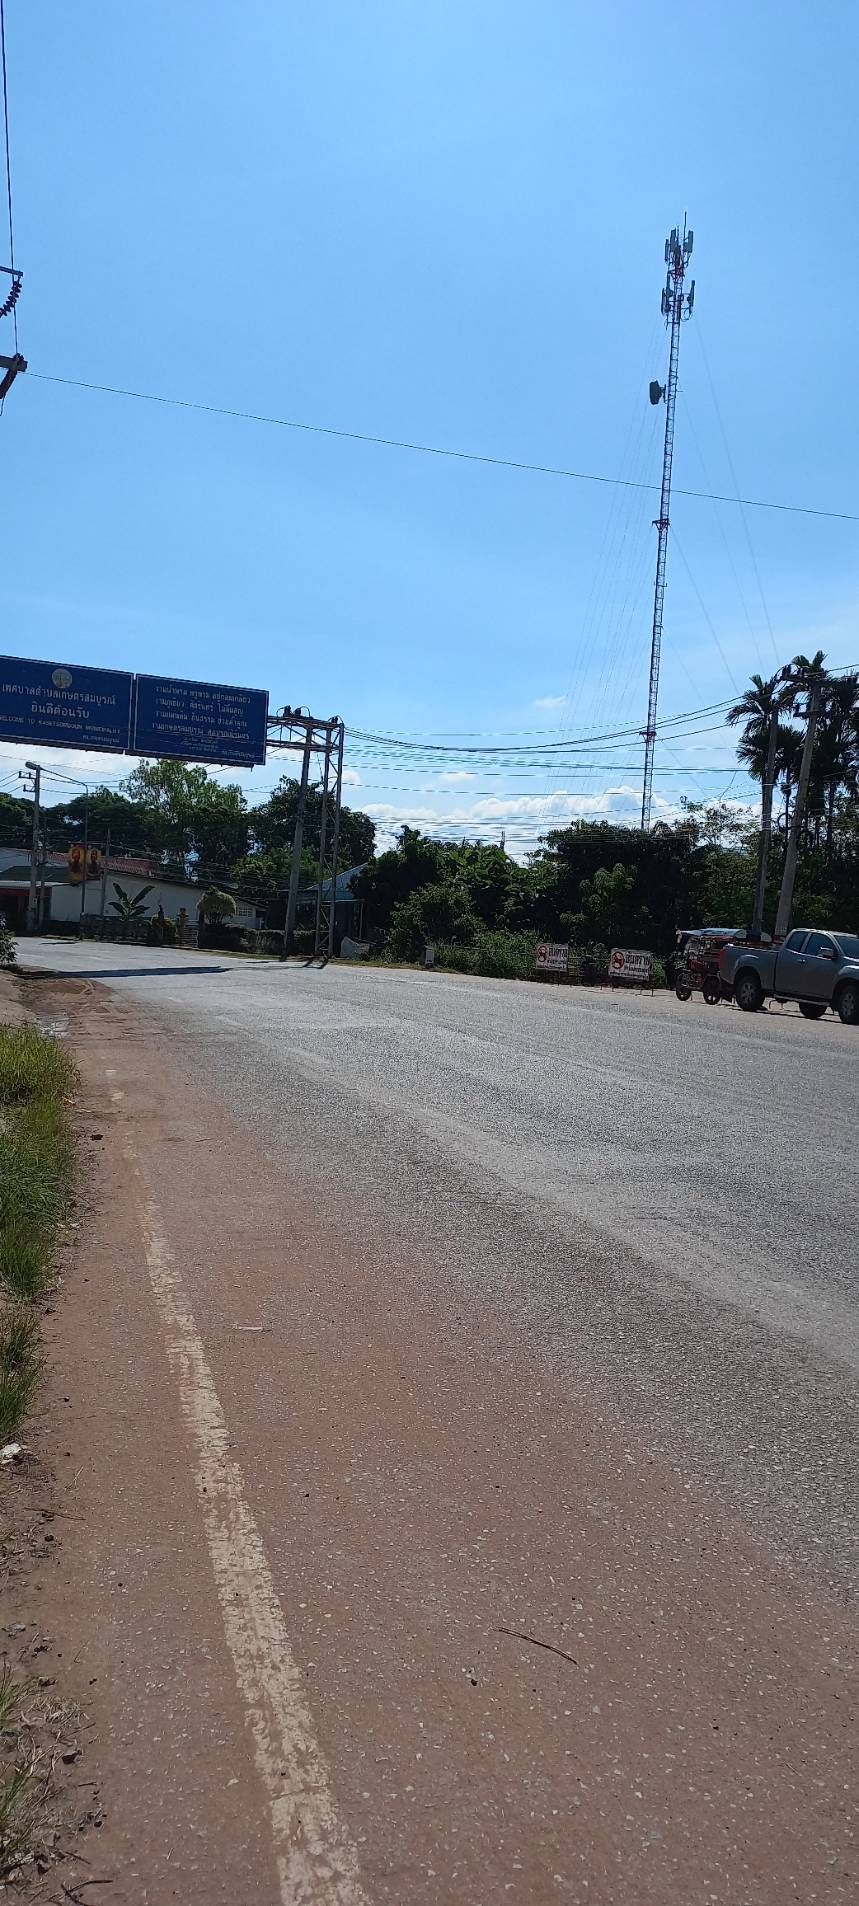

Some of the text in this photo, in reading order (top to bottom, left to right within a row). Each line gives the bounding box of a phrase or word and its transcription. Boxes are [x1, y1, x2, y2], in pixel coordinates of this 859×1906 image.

[31, 701, 90, 719] ยินดีต้อนรับ
[27, 717, 36, 725] TO
